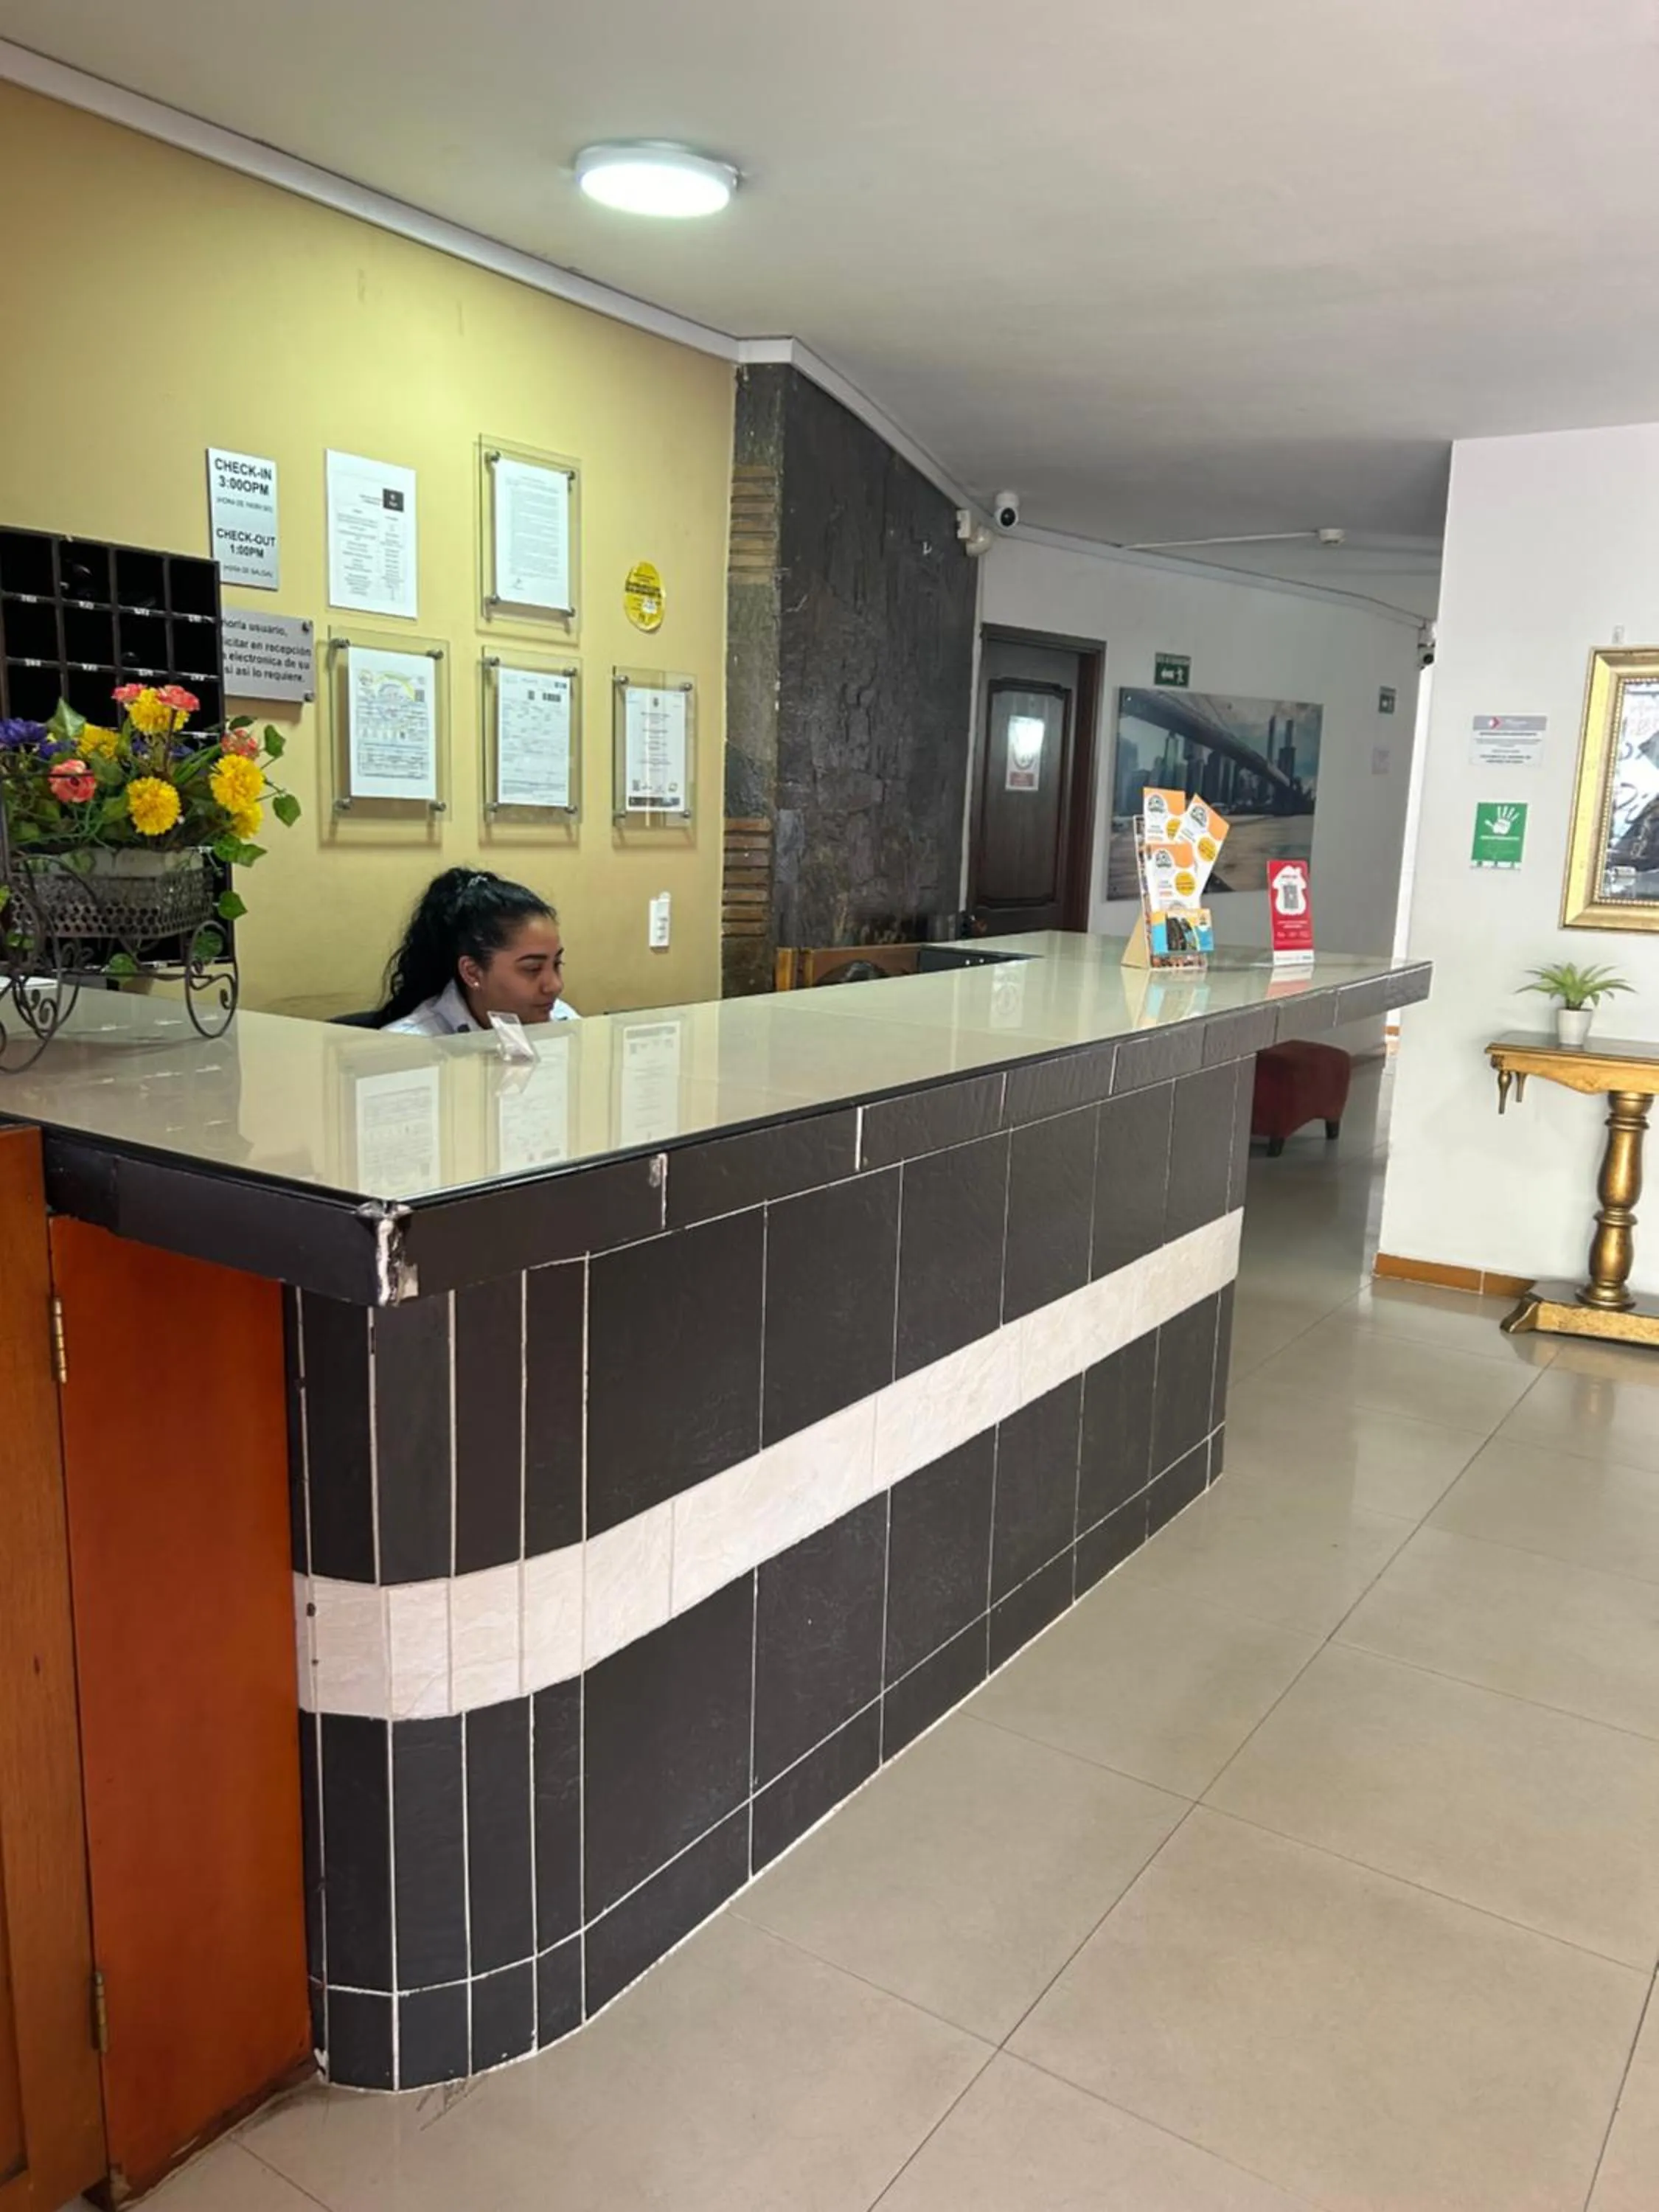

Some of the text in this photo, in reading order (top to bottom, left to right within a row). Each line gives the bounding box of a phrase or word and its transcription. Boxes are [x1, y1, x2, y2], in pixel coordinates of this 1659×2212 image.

[215, 457, 271, 480] CHECK-IN
[216, 528, 276, 547] CHECK-OUT
[230, 544, 263, 558] 1:00PM
[251, 641, 262, 650] en
[284, 658, 296, 668] de
[298, 661, 310, 670] su
[252, 667, 262, 678] lo
